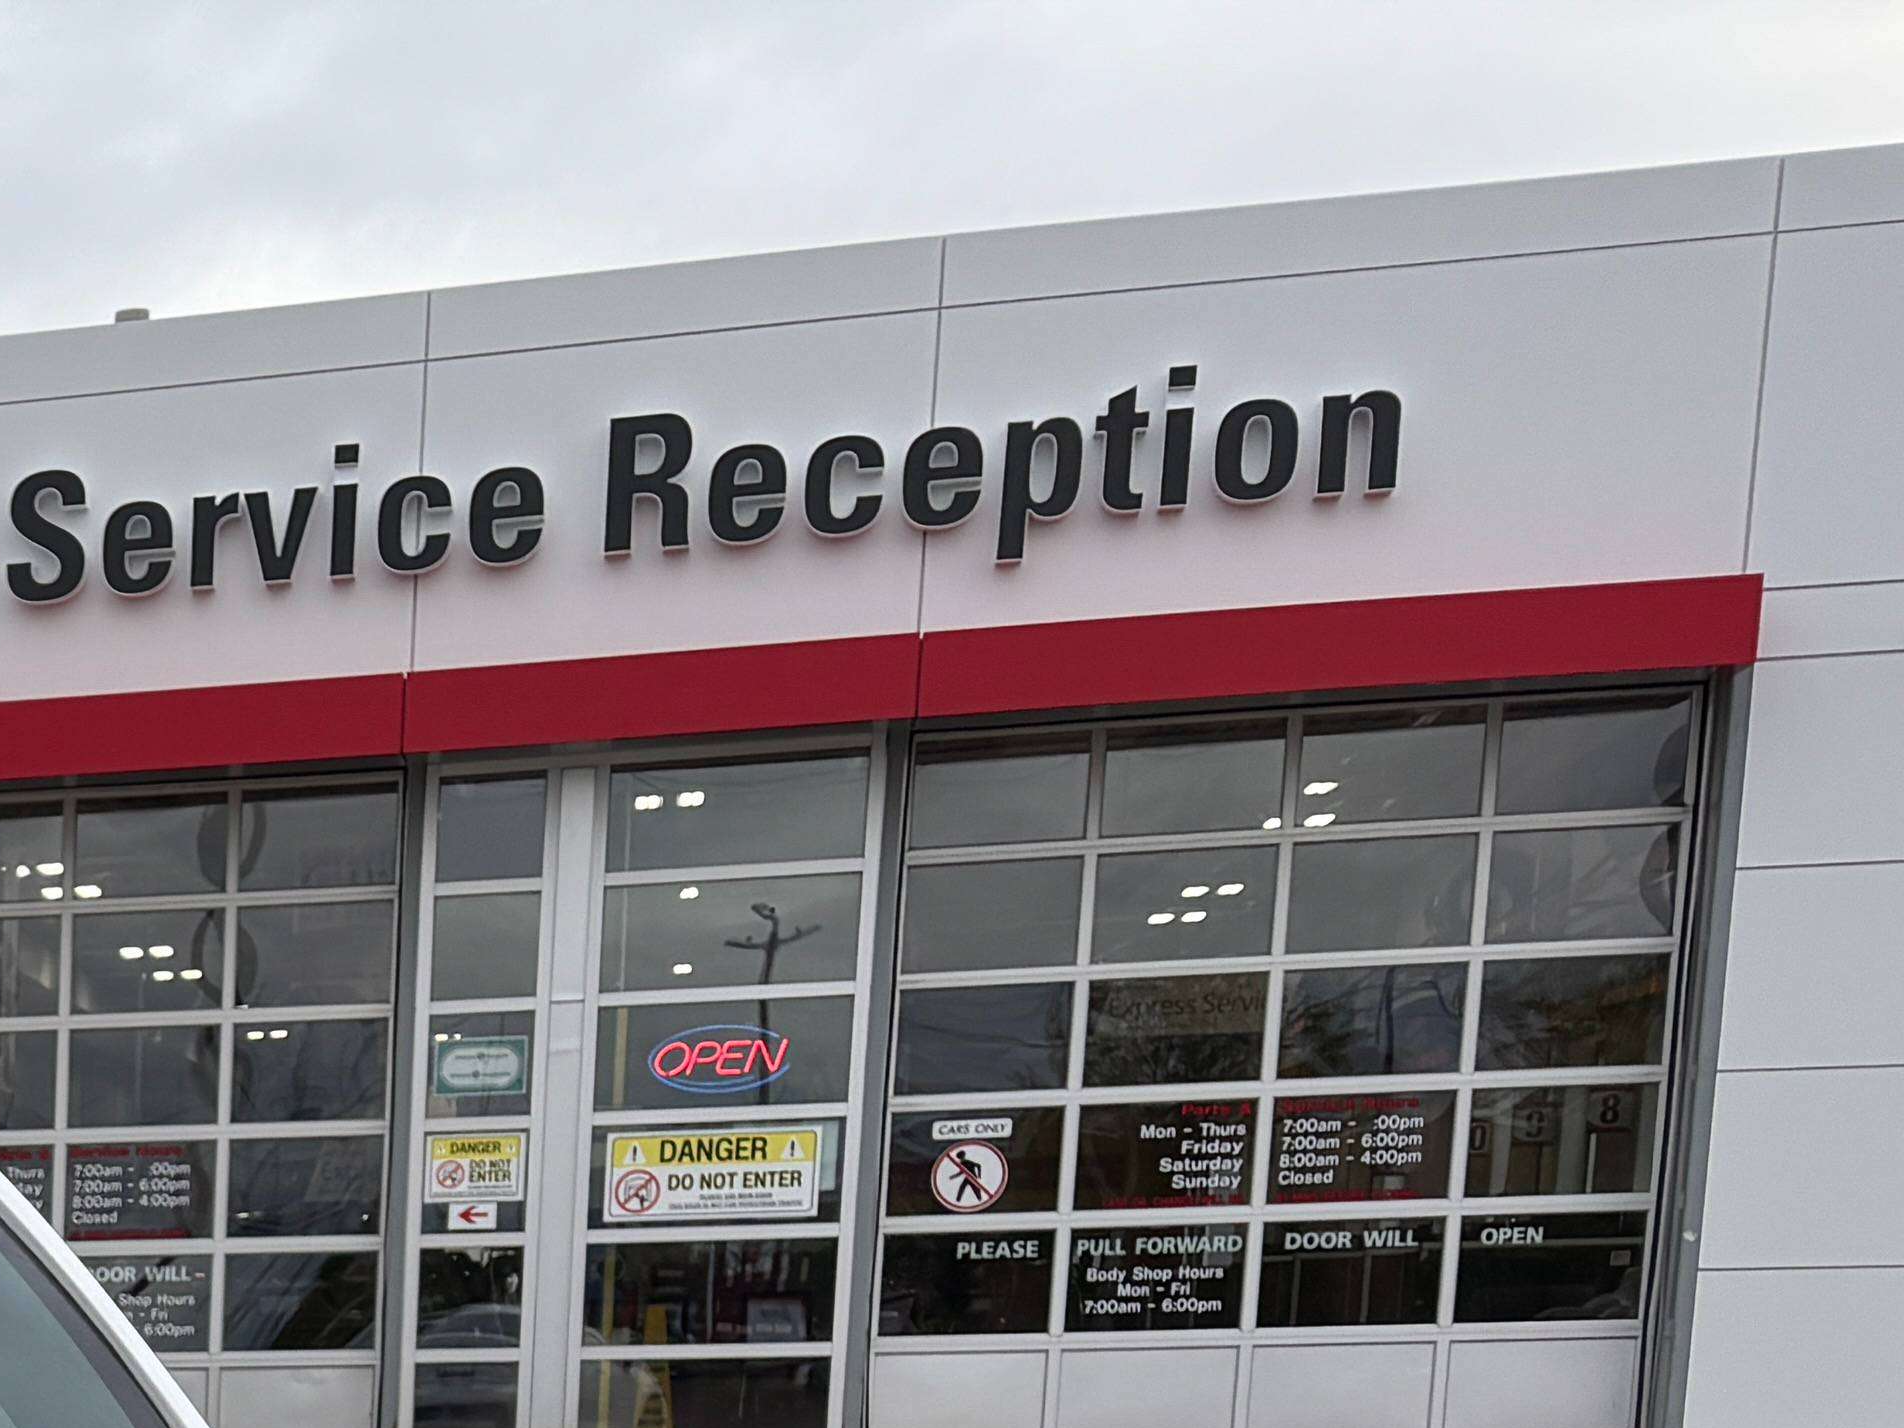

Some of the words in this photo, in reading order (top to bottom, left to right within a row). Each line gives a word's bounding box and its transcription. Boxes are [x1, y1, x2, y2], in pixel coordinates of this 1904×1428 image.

[6, 443, 546, 604] Service
[603, 364, 1403, 565] Reception
[653, 1038, 790, 1077] OPEN
[1600, 1093, 1620, 1124] 8
[938, 1124, 970, 1136] CARS
[975, 1122, 1007, 1134] ONLY
[1140, 1124, 1177, 1139] Mon
[1199, 1122, 1247, 1137] Thurs
[1283, 1118, 1342, 1134] 7:00am
[449, 1140, 502, 1155] DANGER
[659, 1136, 768, 1164] DANGER
[1180, 1140, 1244, 1155] Friday
[1281, 1135, 1341, 1151] 7:00am
[1360, 1131, 1423, 1149] 6:00pm
[469, 1158, 486, 1169] DO
[489, 1158, 511, 1168] NOT
[1159, 1156, 1244, 1173] Saturday
[1279, 1152, 1340, 1169] 8:00am
[1360, 1149, 1423, 1167] 4:00pm
[74, 1163, 123, 1178] 7:00am
[469, 1169, 512, 1182] ENTER
[1171, 1174, 1242, 1190] Sunday
[1278, 1169, 1334, 1186] Closed
[73, 1179, 123, 1193] 7:00am
[139, 1178, 191, 1193] 6:00pm
[667, 1173, 693, 1191] DO
[699, 1172, 738, 1190] NOT
[743, 1170, 802, 1188] ENTER
[73, 1195, 123, 1209] 8:00am
[139, 1193, 190, 1208] 4:00pm
[72, 1210, 118, 1224] Closed
[956, 1240, 1039, 1260] PLEASE
[1077, 1238, 1126, 1257] PULL
[1135, 1235, 1243, 1255] FORWARD
[1284, 1231, 1352, 1250] DOOR
[1363, 1229, 1419, 1248] WILL
[1480, 1226, 1544, 1246] OPEN
[92, 1265, 136, 1283] OOR
[145, 1264, 191, 1282] WILL
[1086, 1267, 1127, 1283] Body
[1132, 1265, 1172, 1282] Shop
[1178, 1265, 1224, 1279] Hours
[1117, 1282, 1150, 1298] Mon
[1170, 1281, 1190, 1296] Fri
[118, 1292, 152, 1307] Shop
[157, 1293, 196, 1306] Hours
[1084, 1299, 1141, 1315] 7:00am
[1161, 1297, 1222, 1314] 6:00pm
[150, 1308, 168, 1321] Fri
[144, 1322, 195, 1338] 6:00pm
